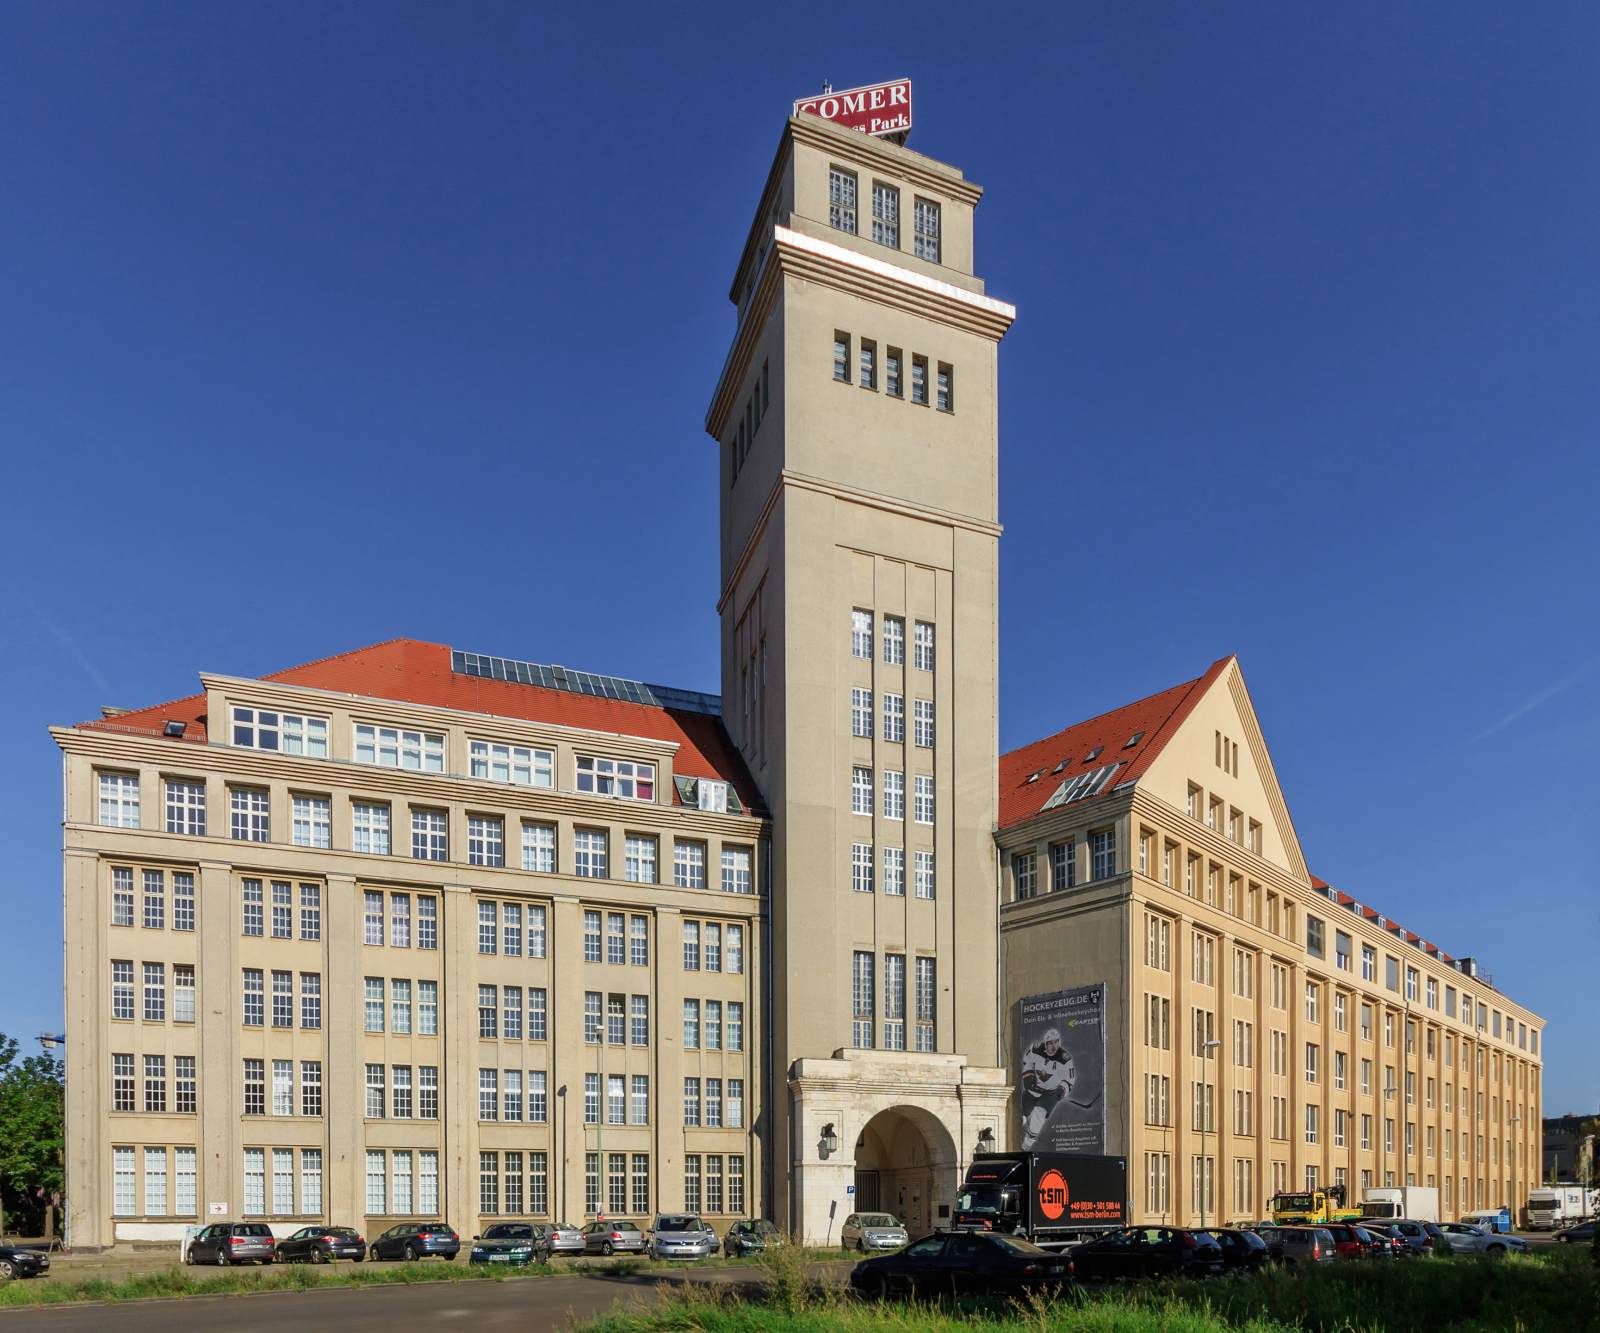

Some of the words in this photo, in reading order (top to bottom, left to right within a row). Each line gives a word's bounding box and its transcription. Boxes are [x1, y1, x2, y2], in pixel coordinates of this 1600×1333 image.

[871, 113, 908, 132] Park
[1024, 995, 1088, 1013] HOCKEYZEUG.DE
[1039, 1188, 1065, 1207] tsm
